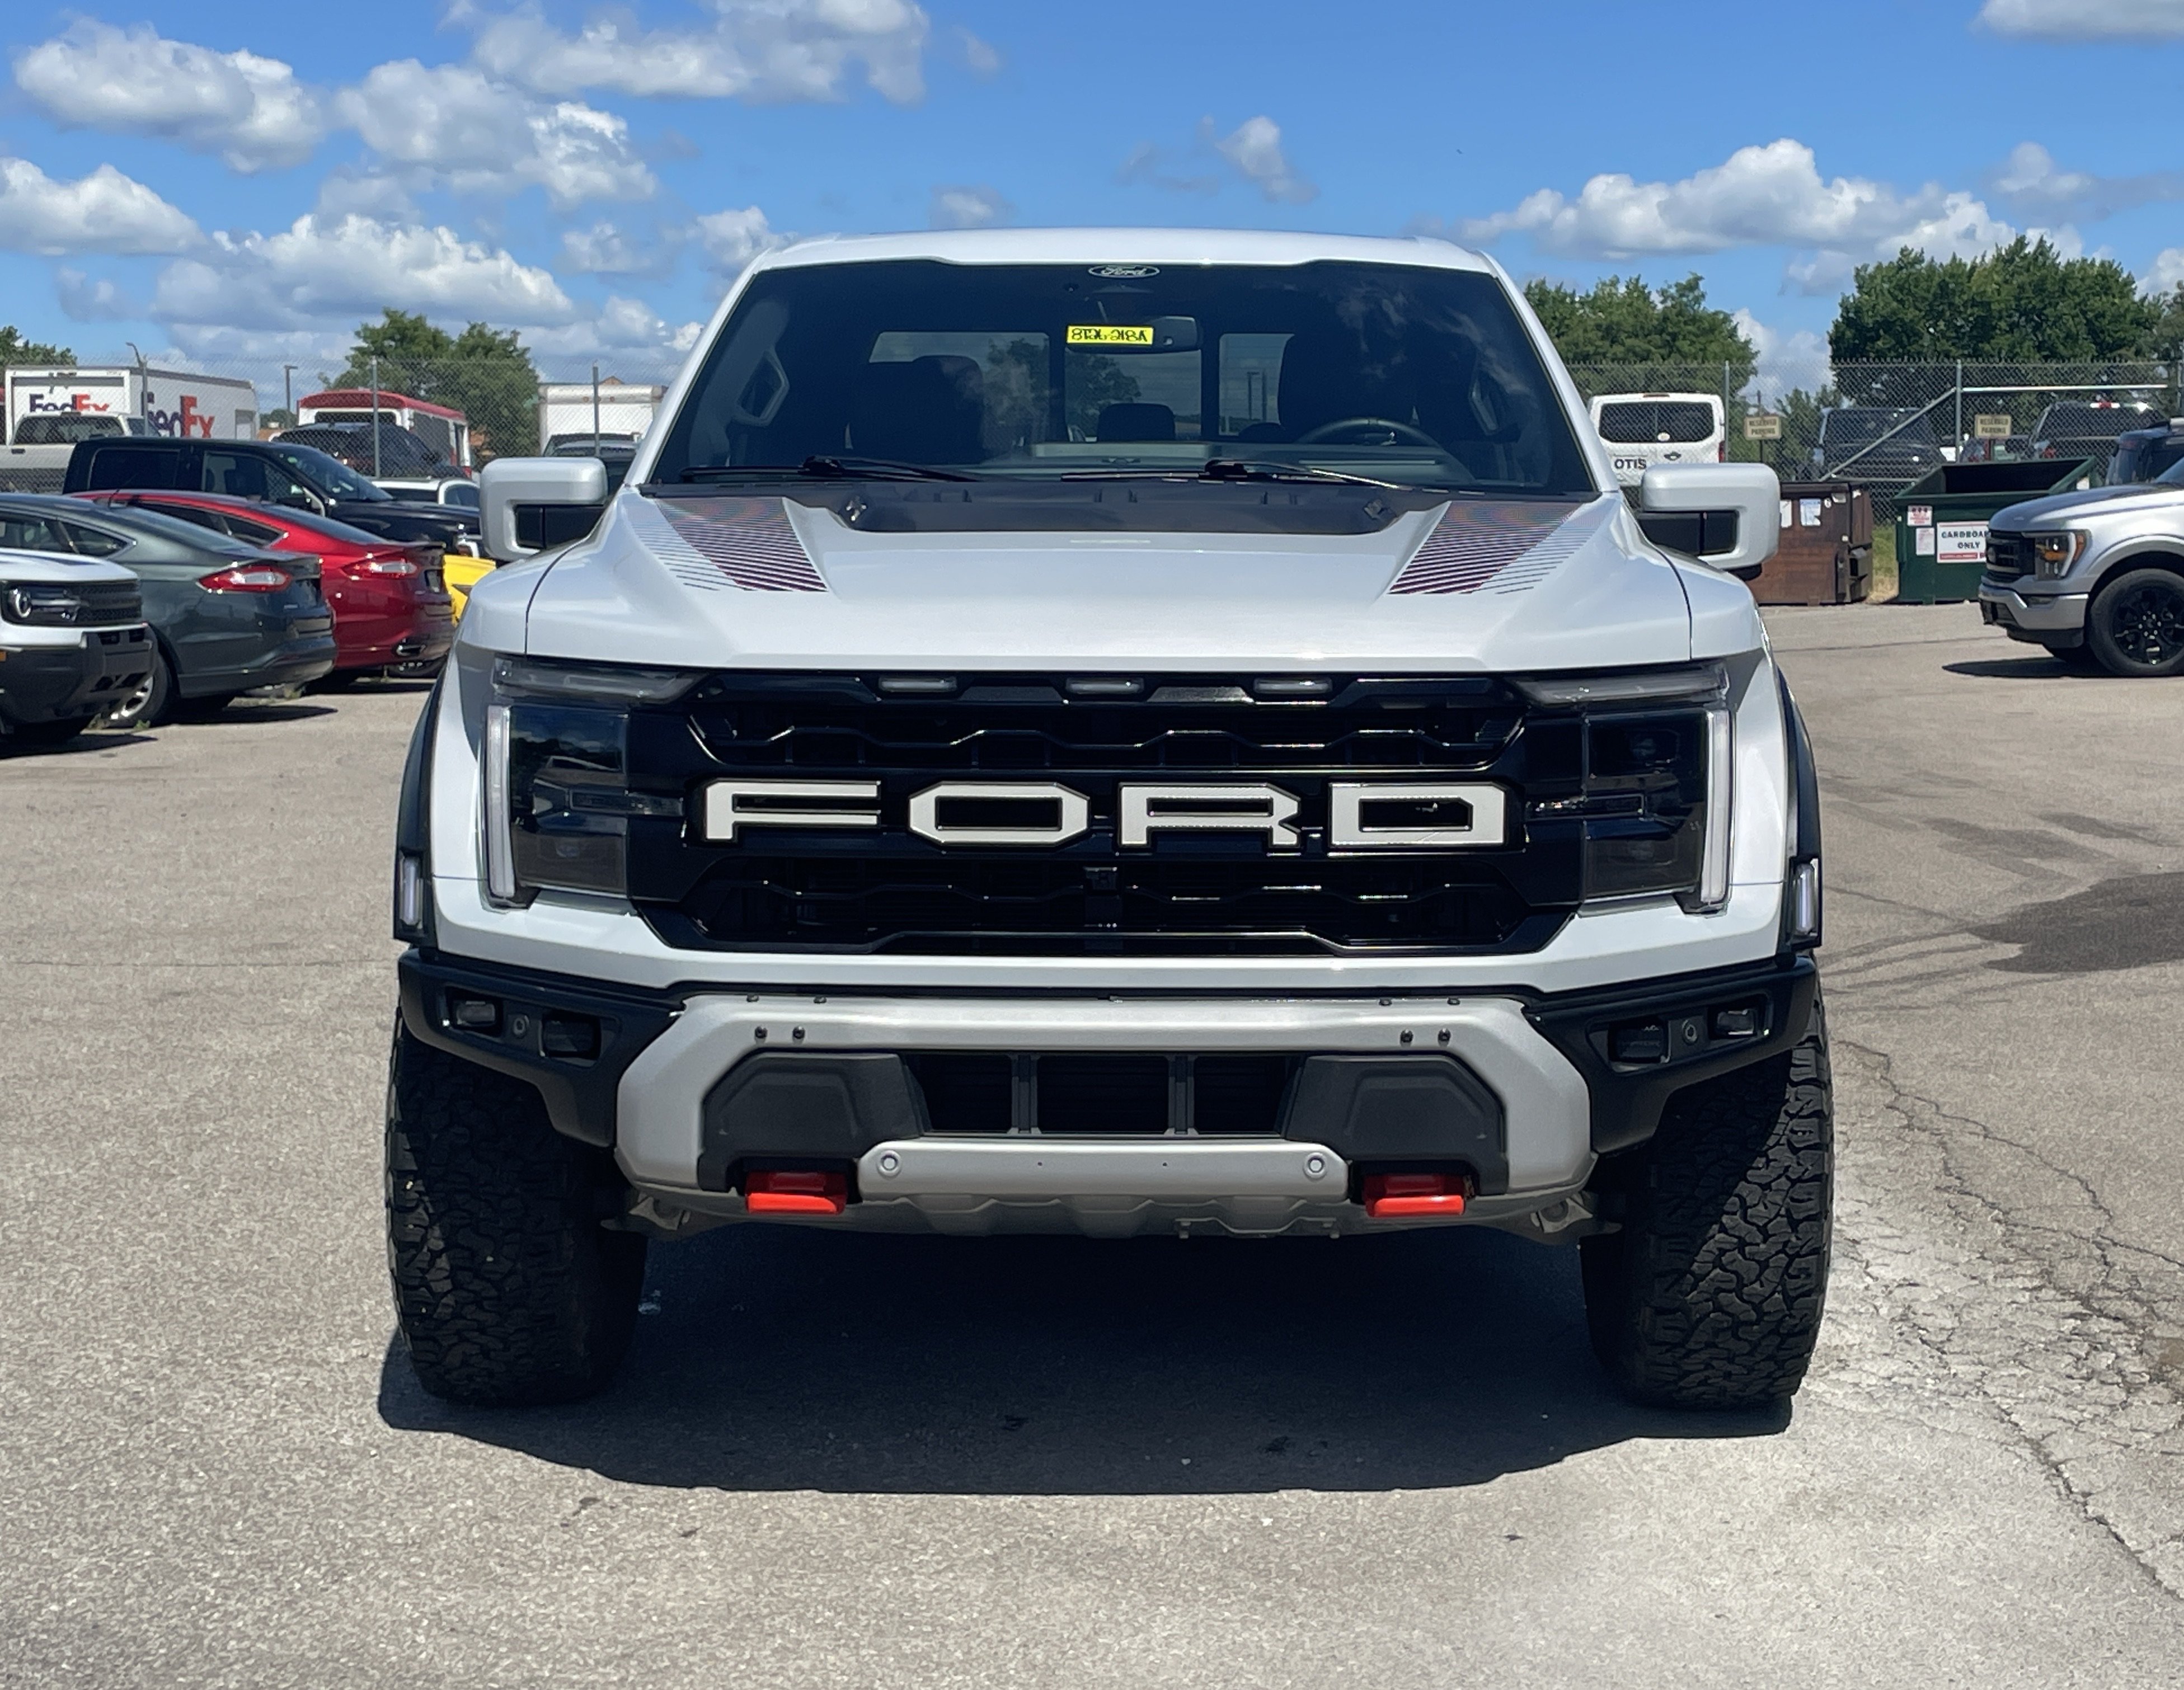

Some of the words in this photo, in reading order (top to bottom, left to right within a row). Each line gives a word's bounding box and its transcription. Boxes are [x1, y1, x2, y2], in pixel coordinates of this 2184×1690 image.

[1101, 265, 1147, 276] Ford
[1614, 459, 1647, 469] OTIS
[705, 780, 1506, 846] FORD
